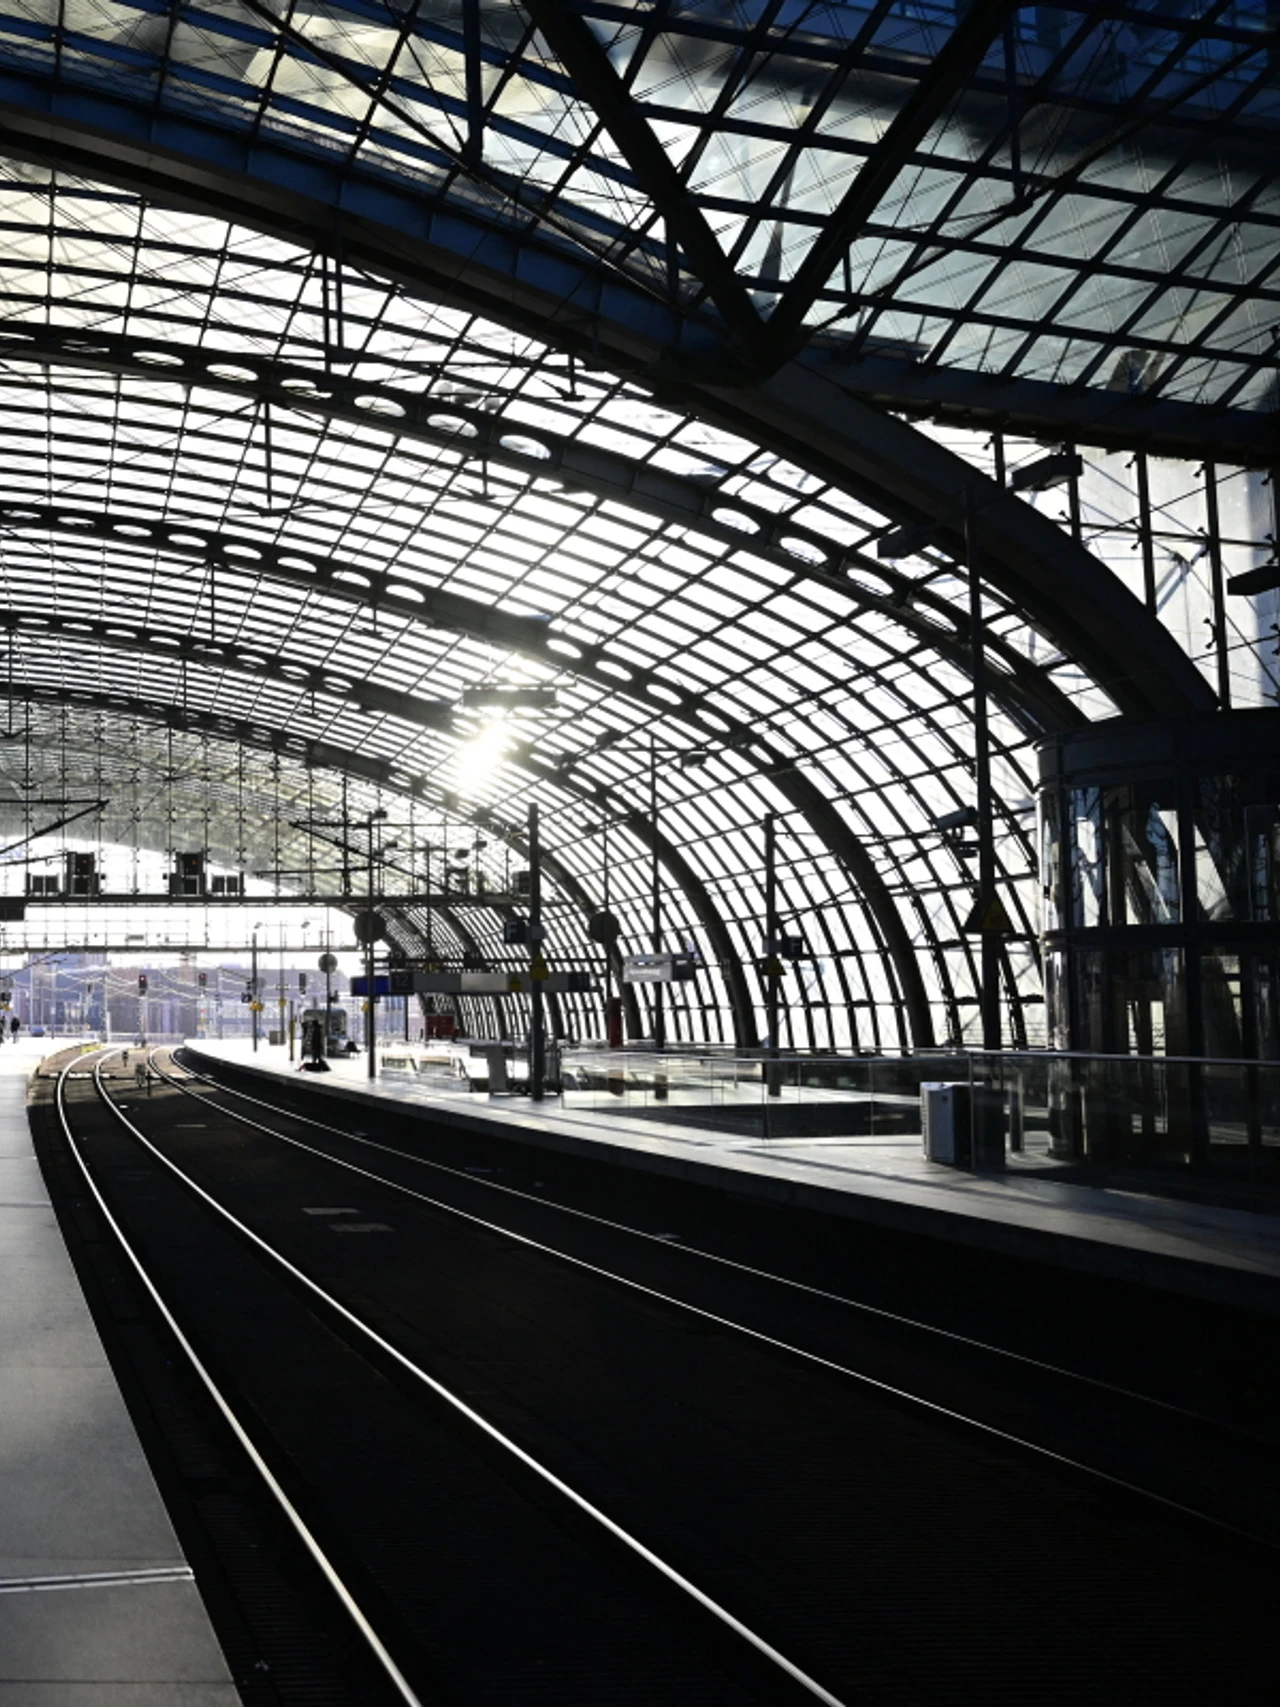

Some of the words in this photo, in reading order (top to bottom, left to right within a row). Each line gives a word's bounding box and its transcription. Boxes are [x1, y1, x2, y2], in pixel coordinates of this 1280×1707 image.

[506, 920, 519, 941] F
[789, 937, 801, 954] F
[394, 975, 410, 988] 12
